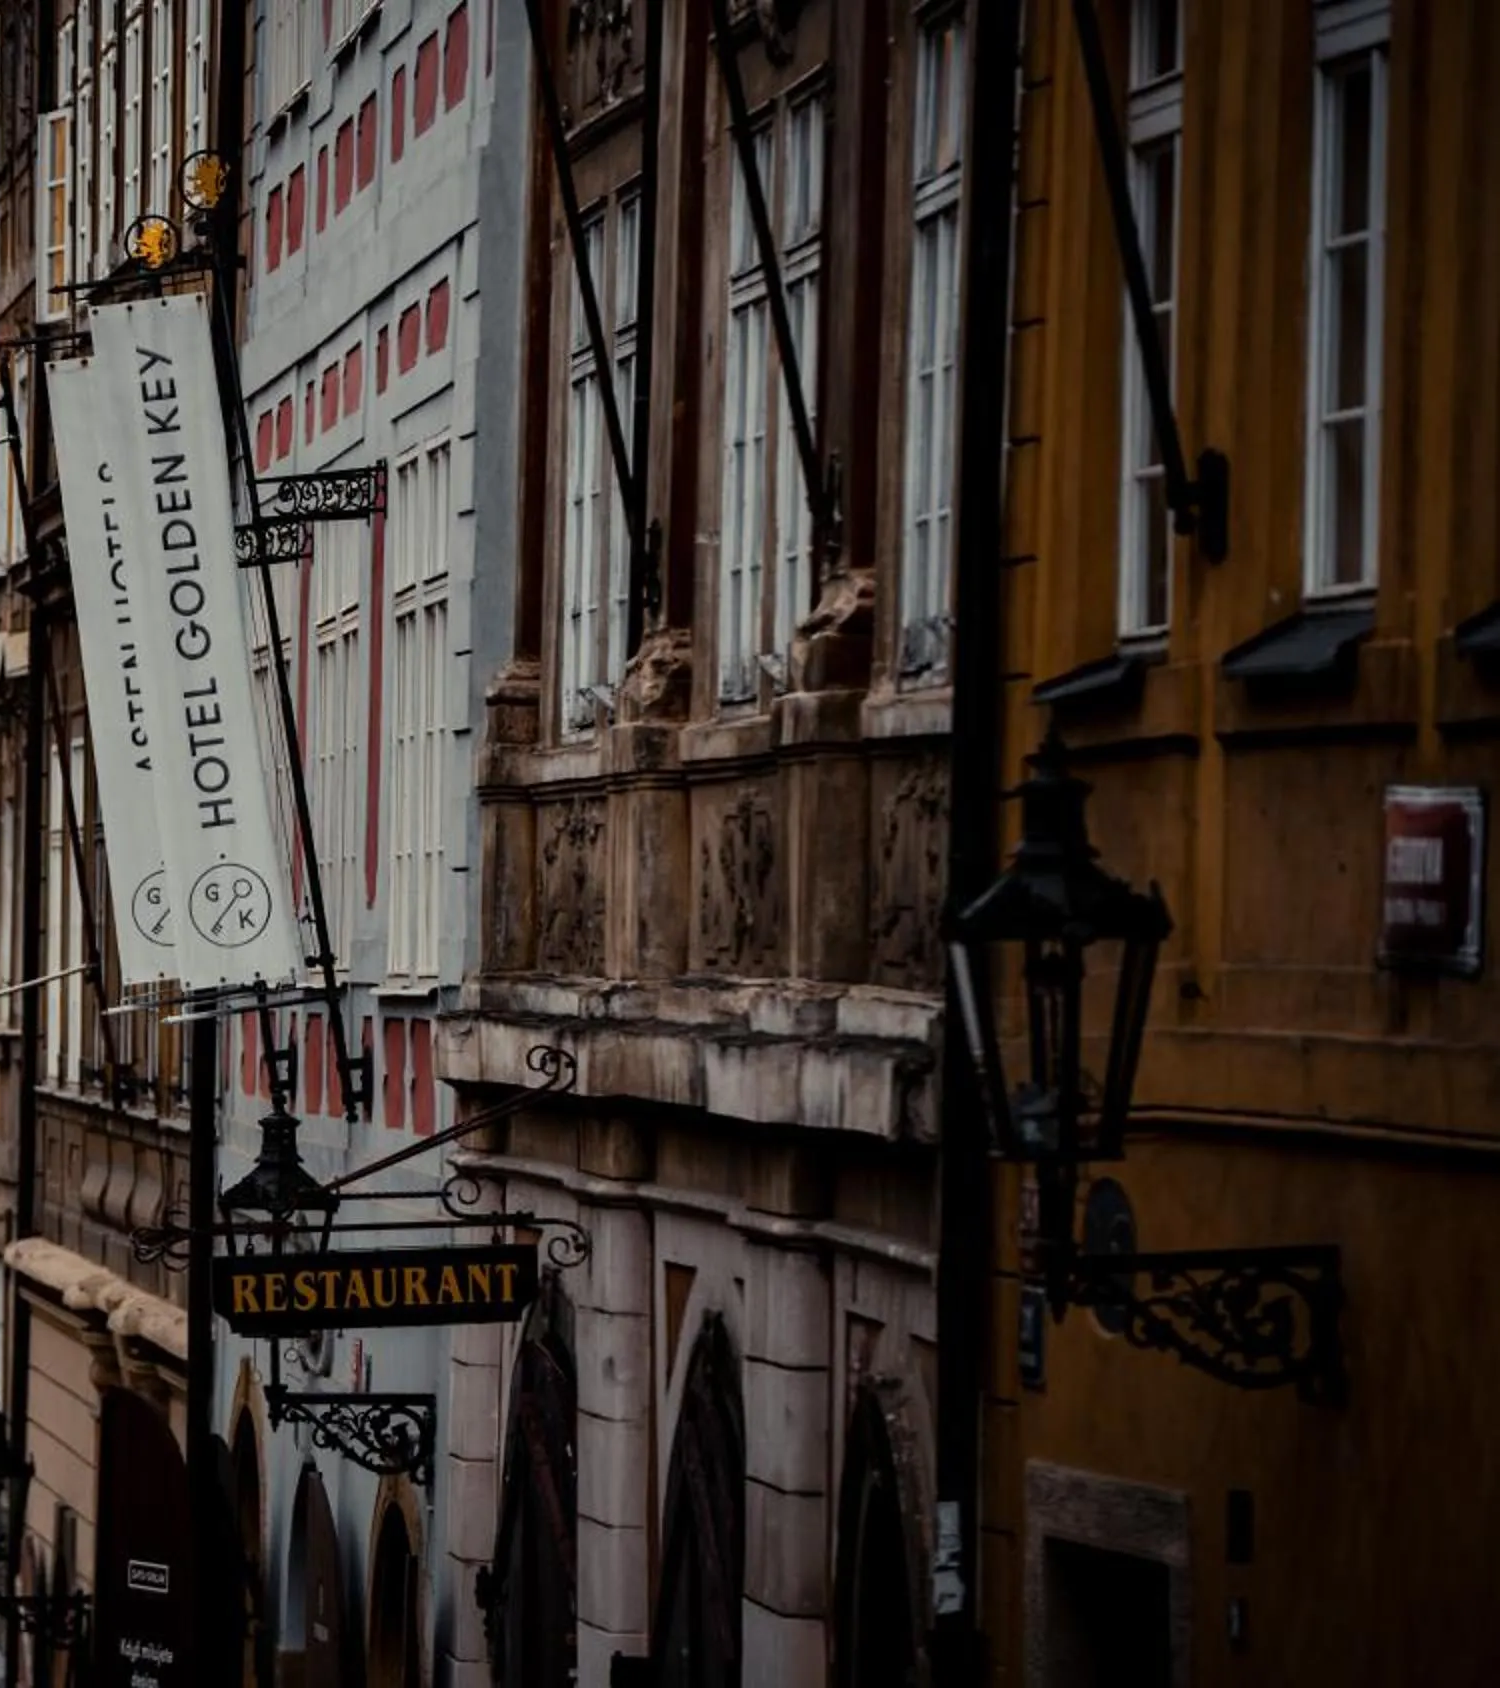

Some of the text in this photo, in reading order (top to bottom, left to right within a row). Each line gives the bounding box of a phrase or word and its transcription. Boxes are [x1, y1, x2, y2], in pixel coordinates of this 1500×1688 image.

[135, 345, 236, 829] HOTEL GOLDEN KEY
[239, 908, 255, 929] K
[231, 1263, 519, 1314] RESTAURANT
